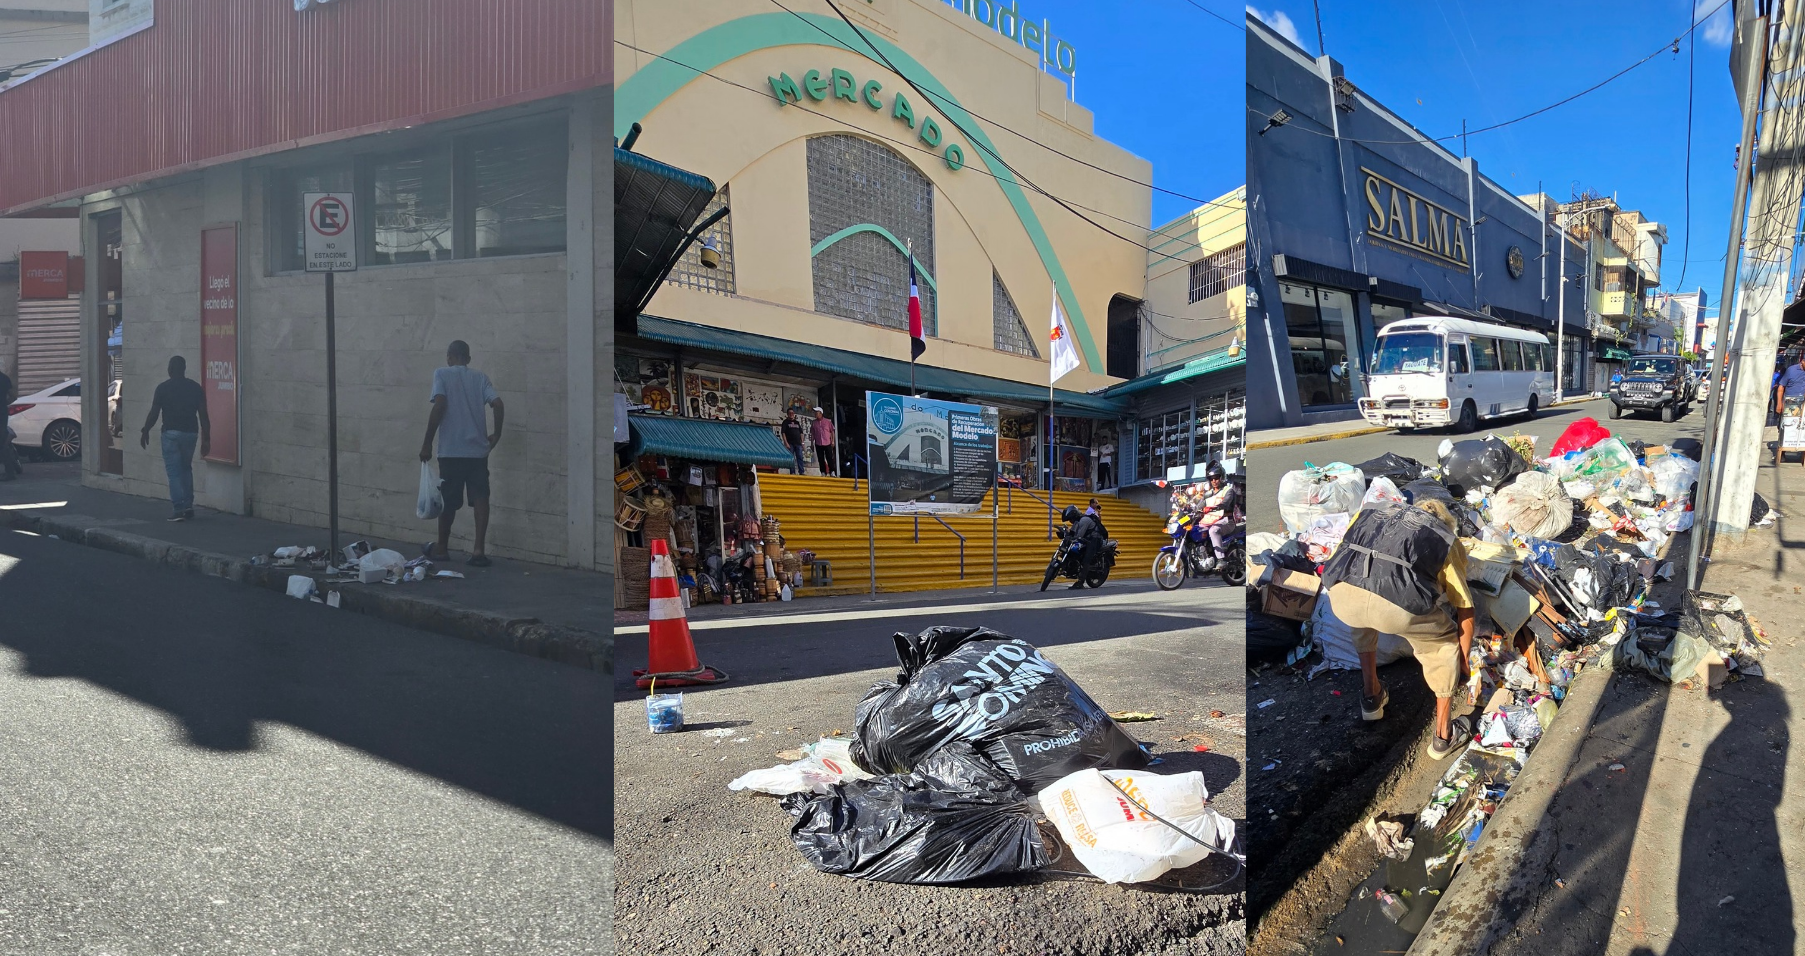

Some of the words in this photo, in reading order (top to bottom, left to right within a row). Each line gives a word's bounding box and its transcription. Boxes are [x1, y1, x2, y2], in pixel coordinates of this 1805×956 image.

[768, 66, 965, 171] MERCADO
[1365, 176, 1468, 263] SALMA
[224, 275, 230, 288] el
[220, 296, 228, 309] de
[952, 424, 964, 432] del
[964, 425, 993, 434] Mercado
[952, 431, 979, 440] Modelo
[932, 644, 1027, 728] SANTO
[1061, 788, 1078, 815] REDUCE
[1116, 796, 1135, 822] JUM
